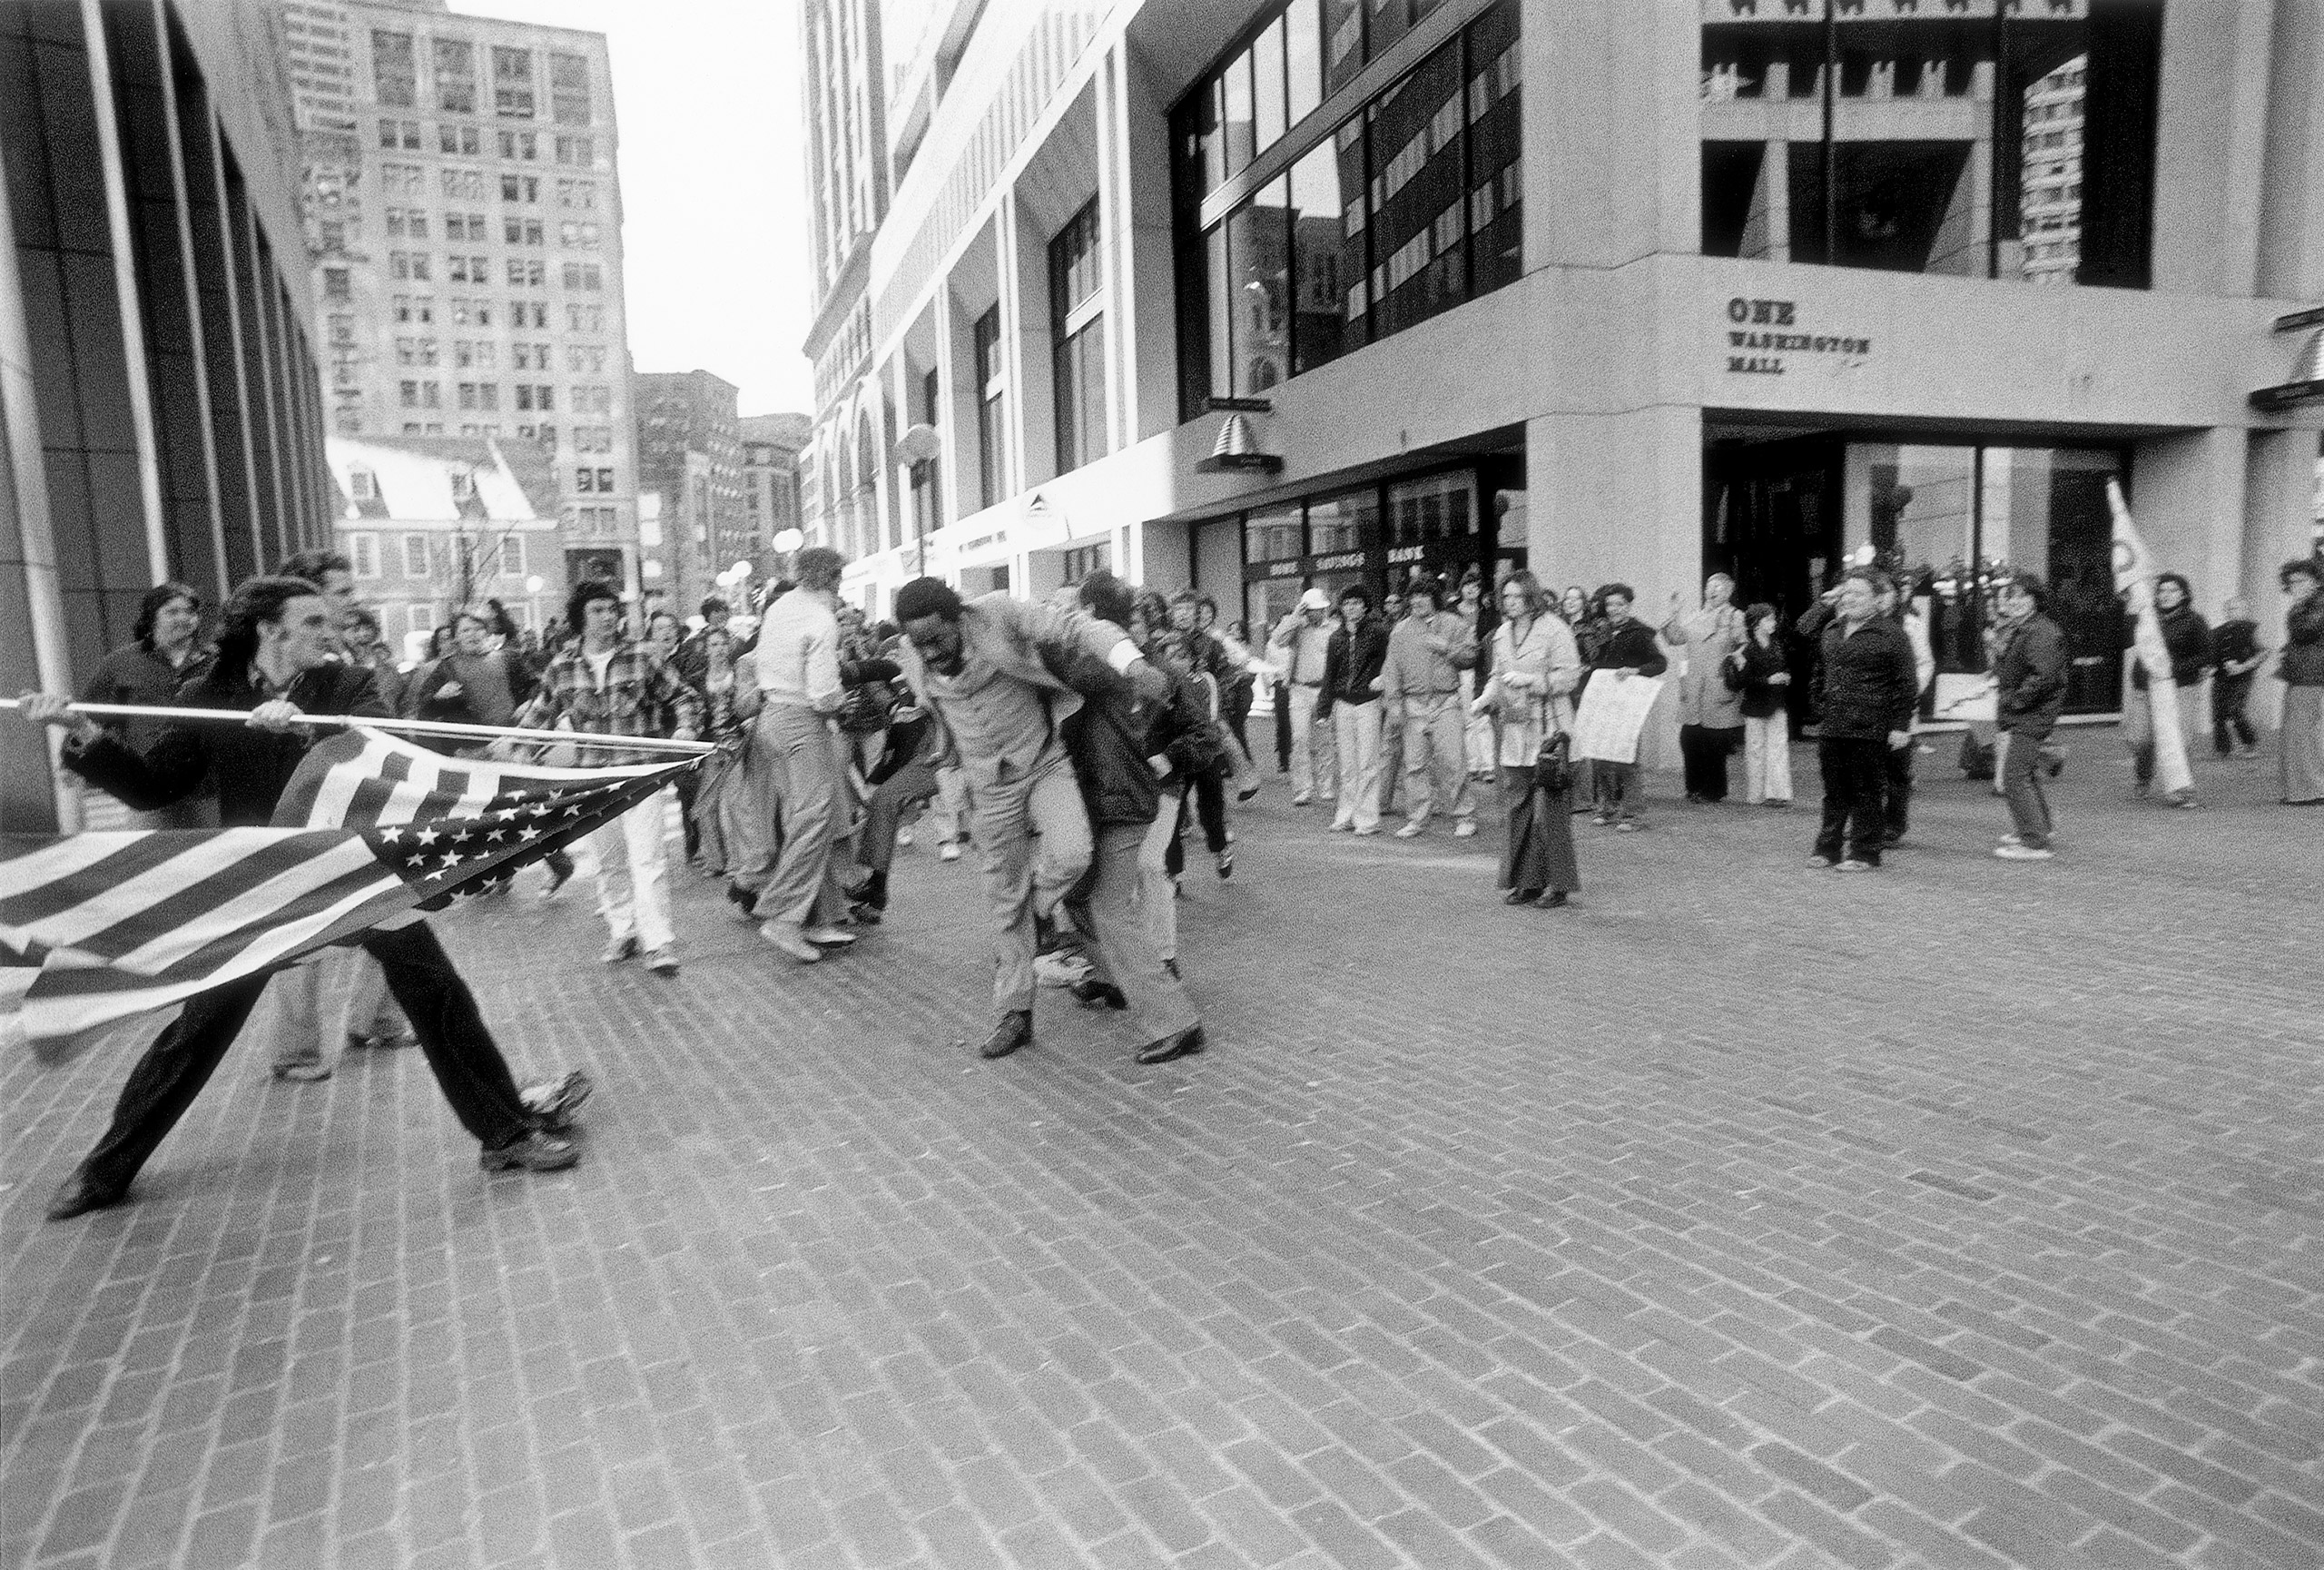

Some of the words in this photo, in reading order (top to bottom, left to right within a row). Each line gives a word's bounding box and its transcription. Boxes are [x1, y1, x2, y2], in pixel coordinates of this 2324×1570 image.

[1728, 298, 1795, 325] ONE
[1728, 331, 1870, 353] WASHINGTON
[1728, 356, 1785, 375] MALL
